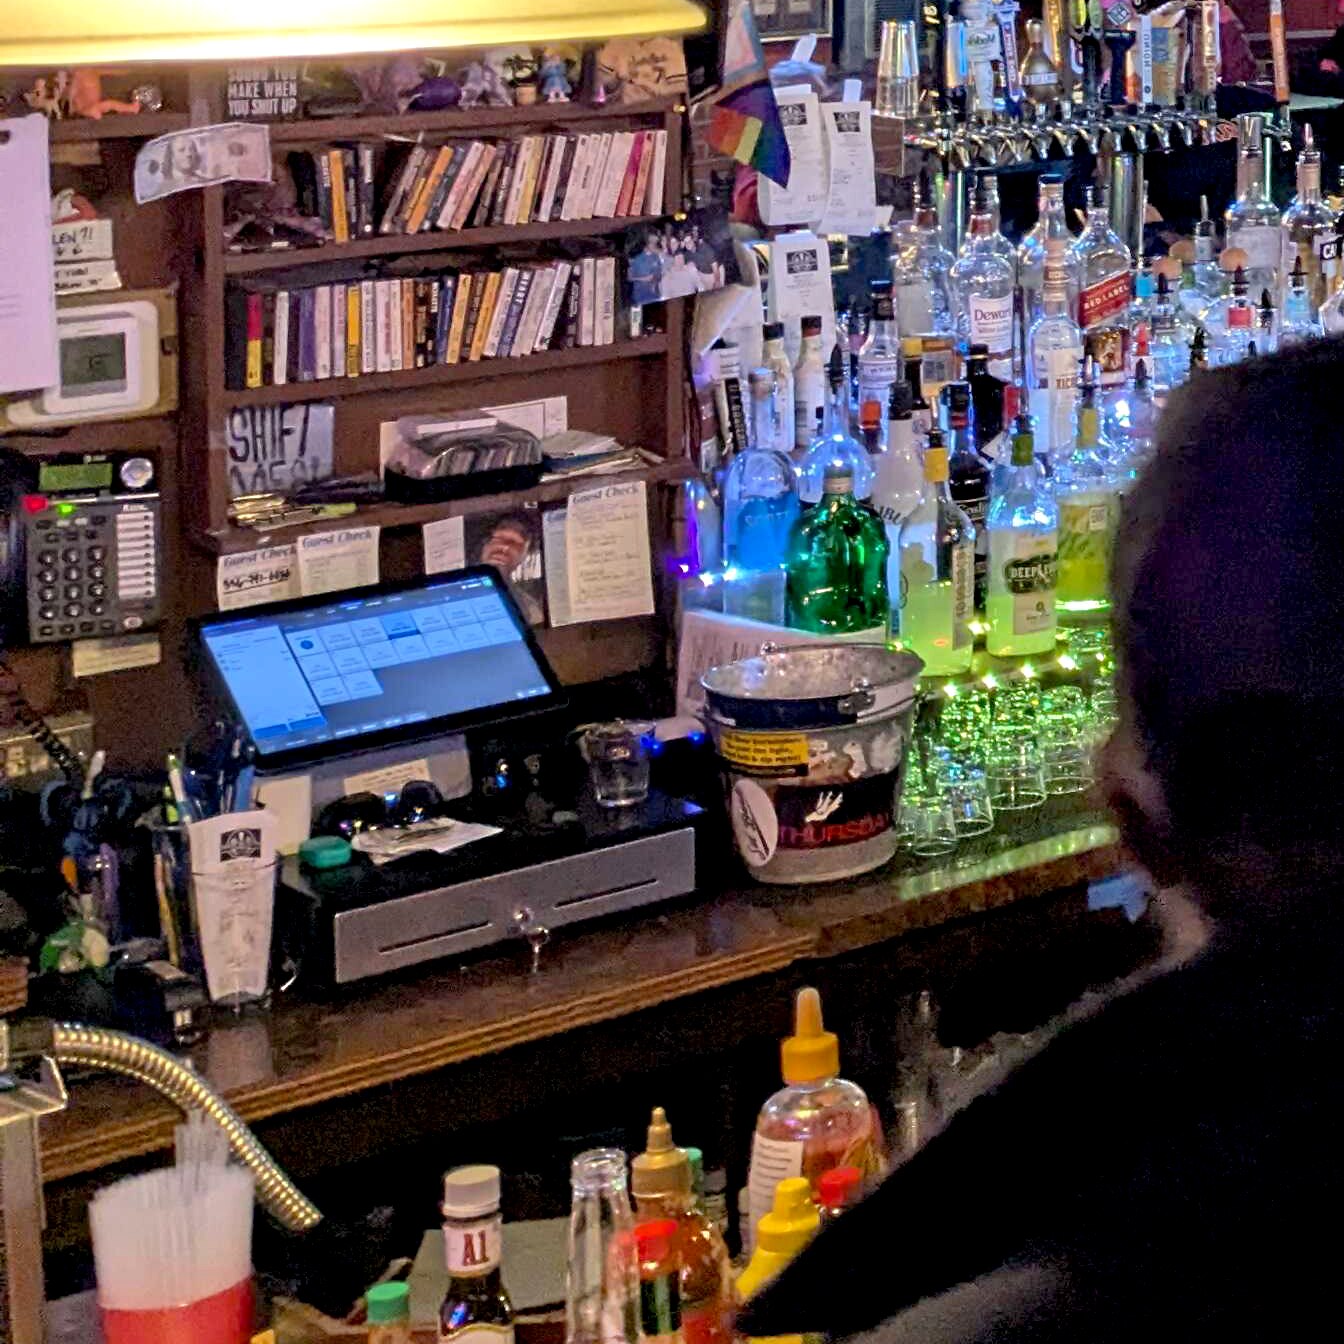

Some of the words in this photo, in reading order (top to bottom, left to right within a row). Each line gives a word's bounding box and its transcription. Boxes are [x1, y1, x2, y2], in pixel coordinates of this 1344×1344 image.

[228, 82, 261, 99] MAKE
[264, 81, 297, 98] WHEN
[281, 98, 297, 114] UP
[1083, 295, 1102, 310] RED
[1101, 285, 1129, 303] LABEL
[337, 529, 372, 543] Check
[463, 1229, 489, 1267] A1
